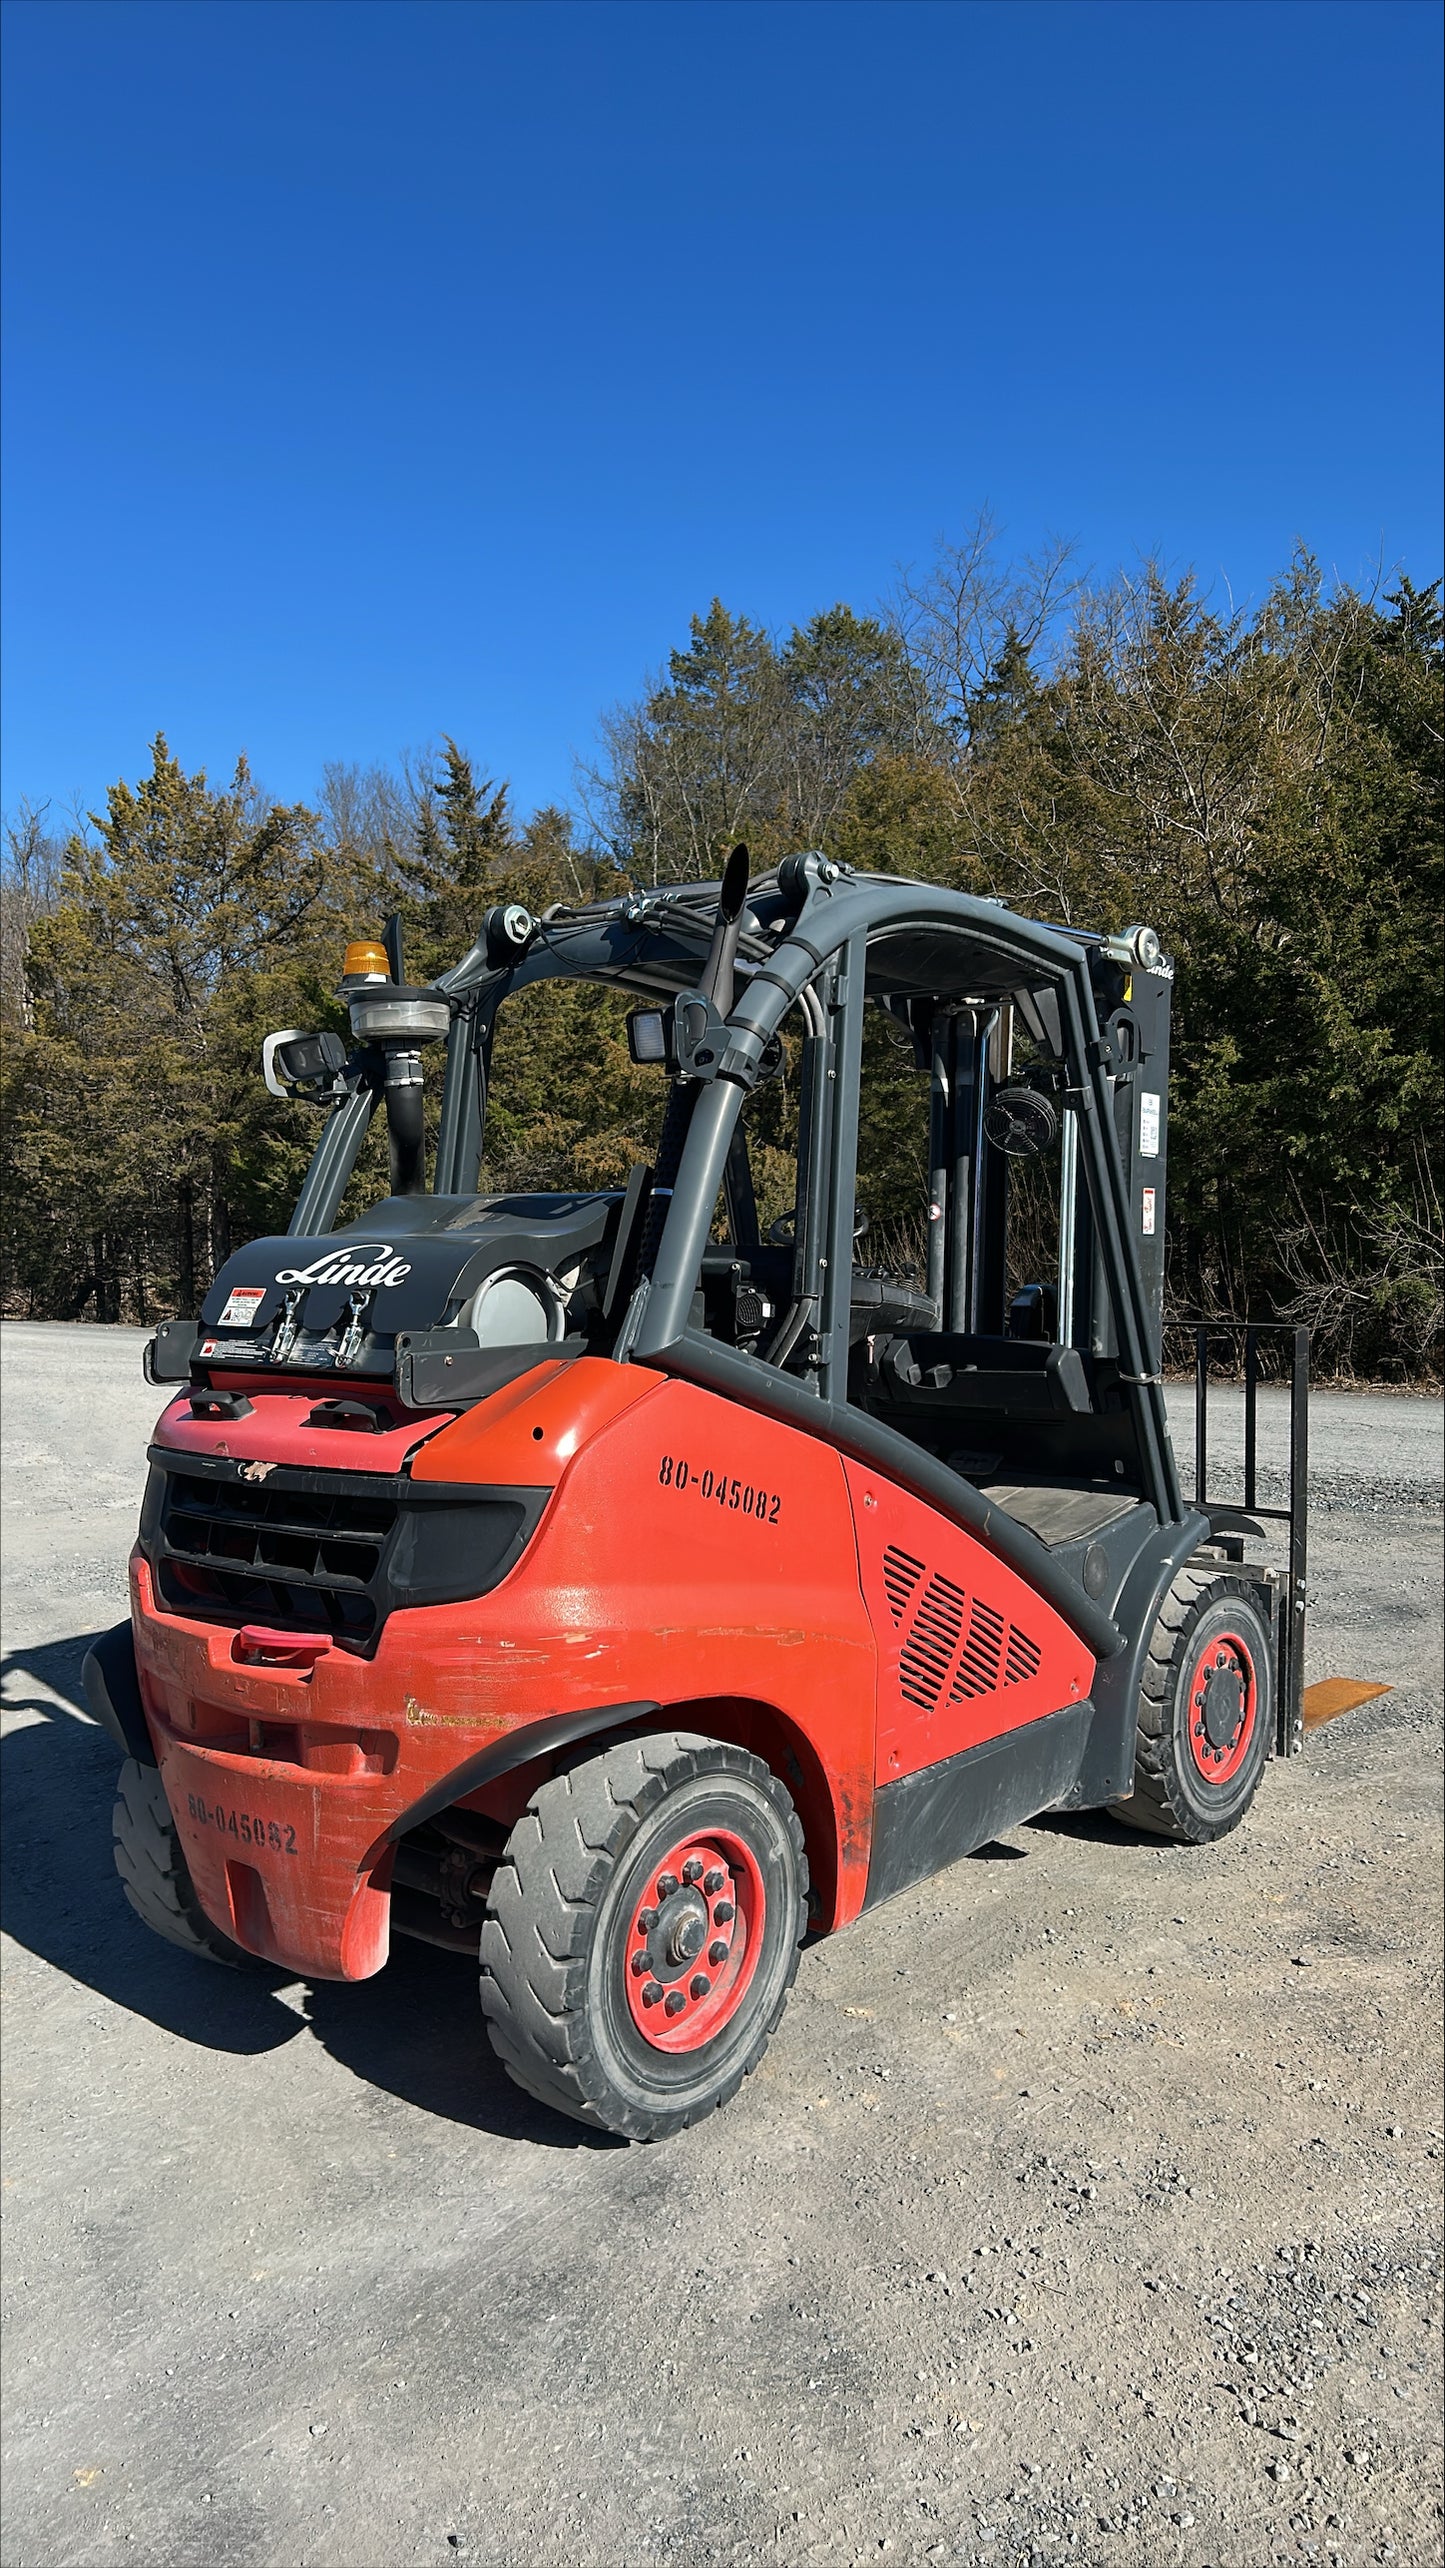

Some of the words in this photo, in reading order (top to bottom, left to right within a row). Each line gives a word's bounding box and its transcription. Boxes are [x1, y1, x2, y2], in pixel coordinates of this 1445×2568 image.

[1145, 954, 1174, 980] inde
[274, 1243, 412, 1287] Linde
[658, 1455, 781, 1525] 80-045082
[188, 1792, 298, 1856] 80-045082
